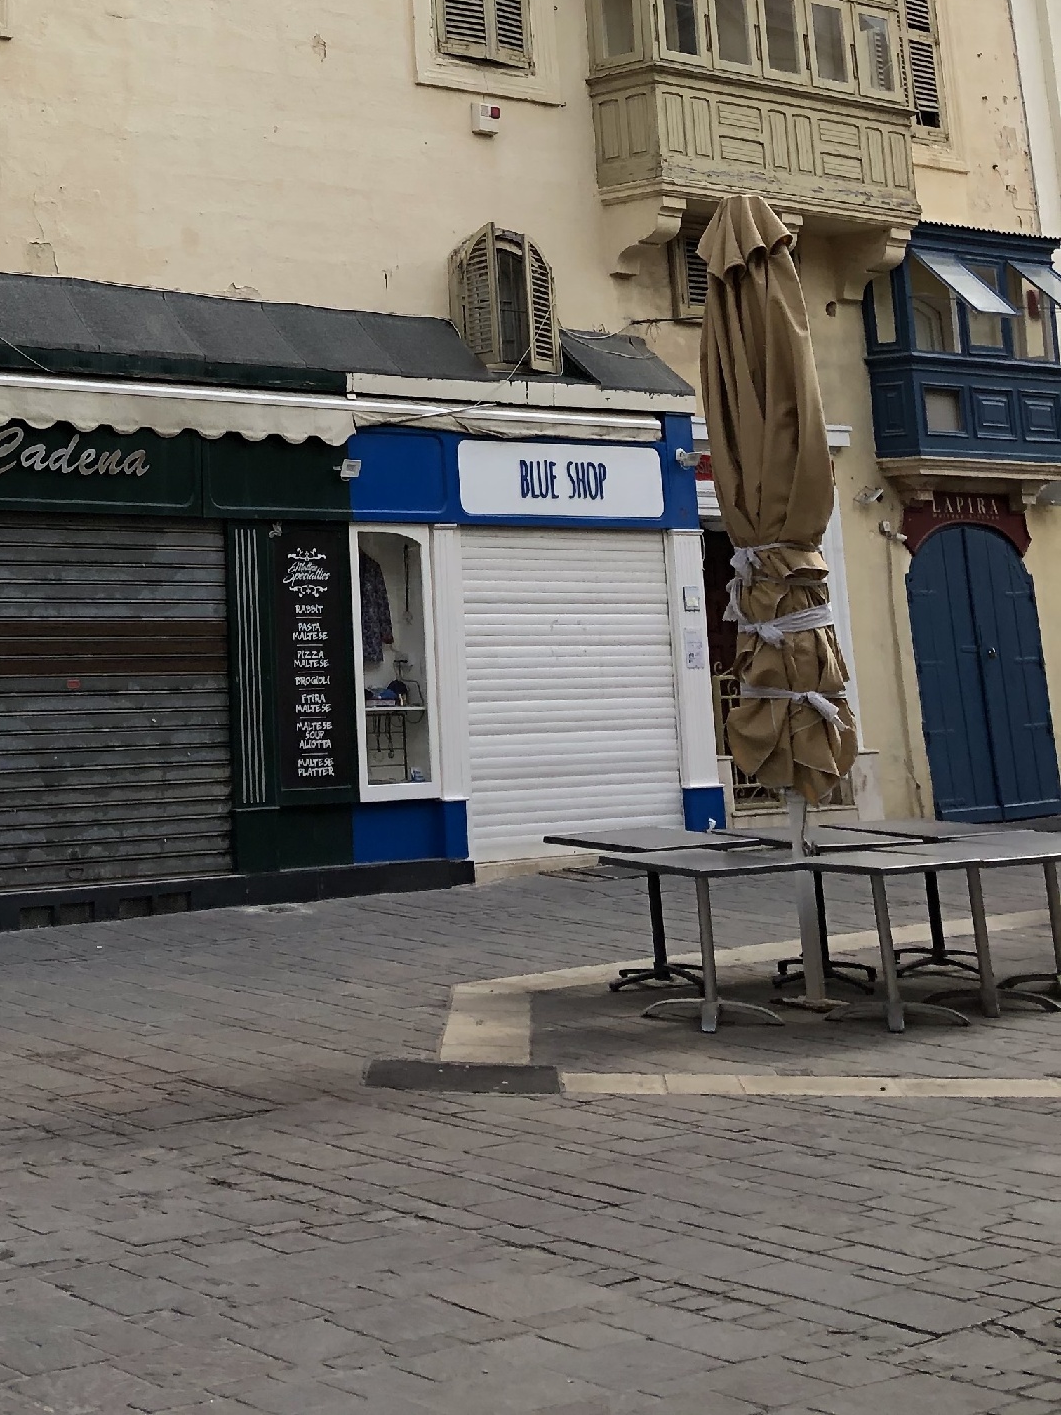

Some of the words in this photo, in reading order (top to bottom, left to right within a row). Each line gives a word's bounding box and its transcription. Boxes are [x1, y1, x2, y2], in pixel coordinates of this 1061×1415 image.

[519, 459, 559, 500] BLUE
[567, 461, 607, 501] SHOP
[295, 604, 324, 614] RABBIT
[298, 622, 321, 632] PASTA
[292, 631, 329, 641] MALTESE
[297, 650, 325, 659] PIZZA
[294, 659, 330, 668] MALTESE
[301, 693, 327, 704] FTIRA
[295, 703, 332, 714] MALTESE
[296, 721, 333, 732] MALTESE
[305, 730, 325, 740] SOUP
[299, 739, 332, 750] ALIOTTA
[297, 757, 334, 767] MALTESE
[298, 766, 335, 777] PLATTER
